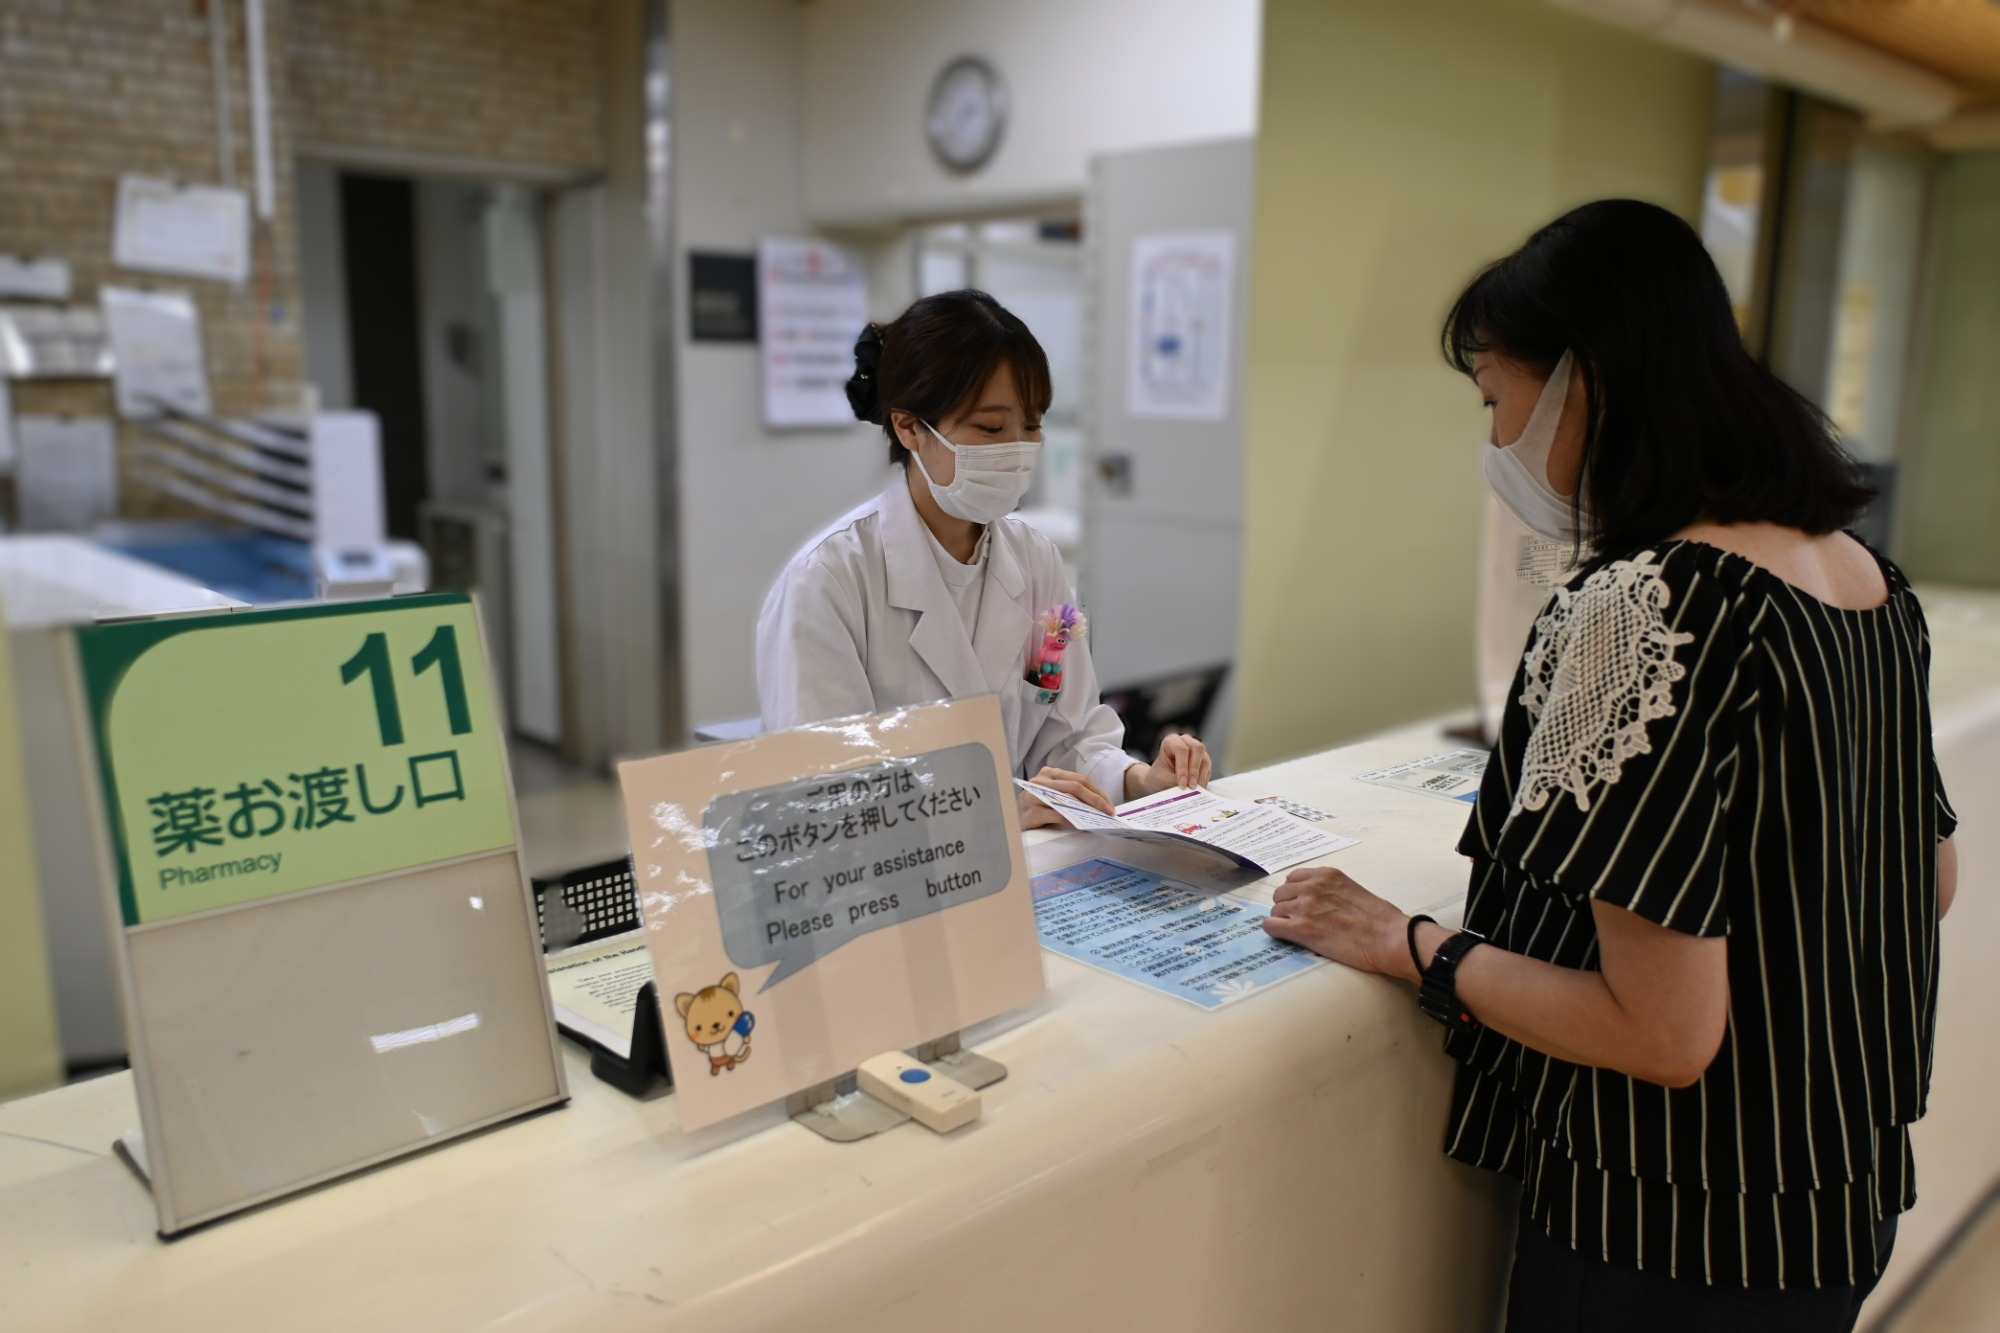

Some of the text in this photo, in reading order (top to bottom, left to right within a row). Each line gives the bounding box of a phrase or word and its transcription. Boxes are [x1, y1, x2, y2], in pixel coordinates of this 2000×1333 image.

[341, 624, 473, 747] 11
[147, 749, 466, 858] 薬お渡し口
[736, 785, 981, 863] このボタンを押してください
[159, 852, 283, 890] Pharmacy
[766, 869, 982, 945] Please press button
[774, 839, 966, 904] For your assistance
